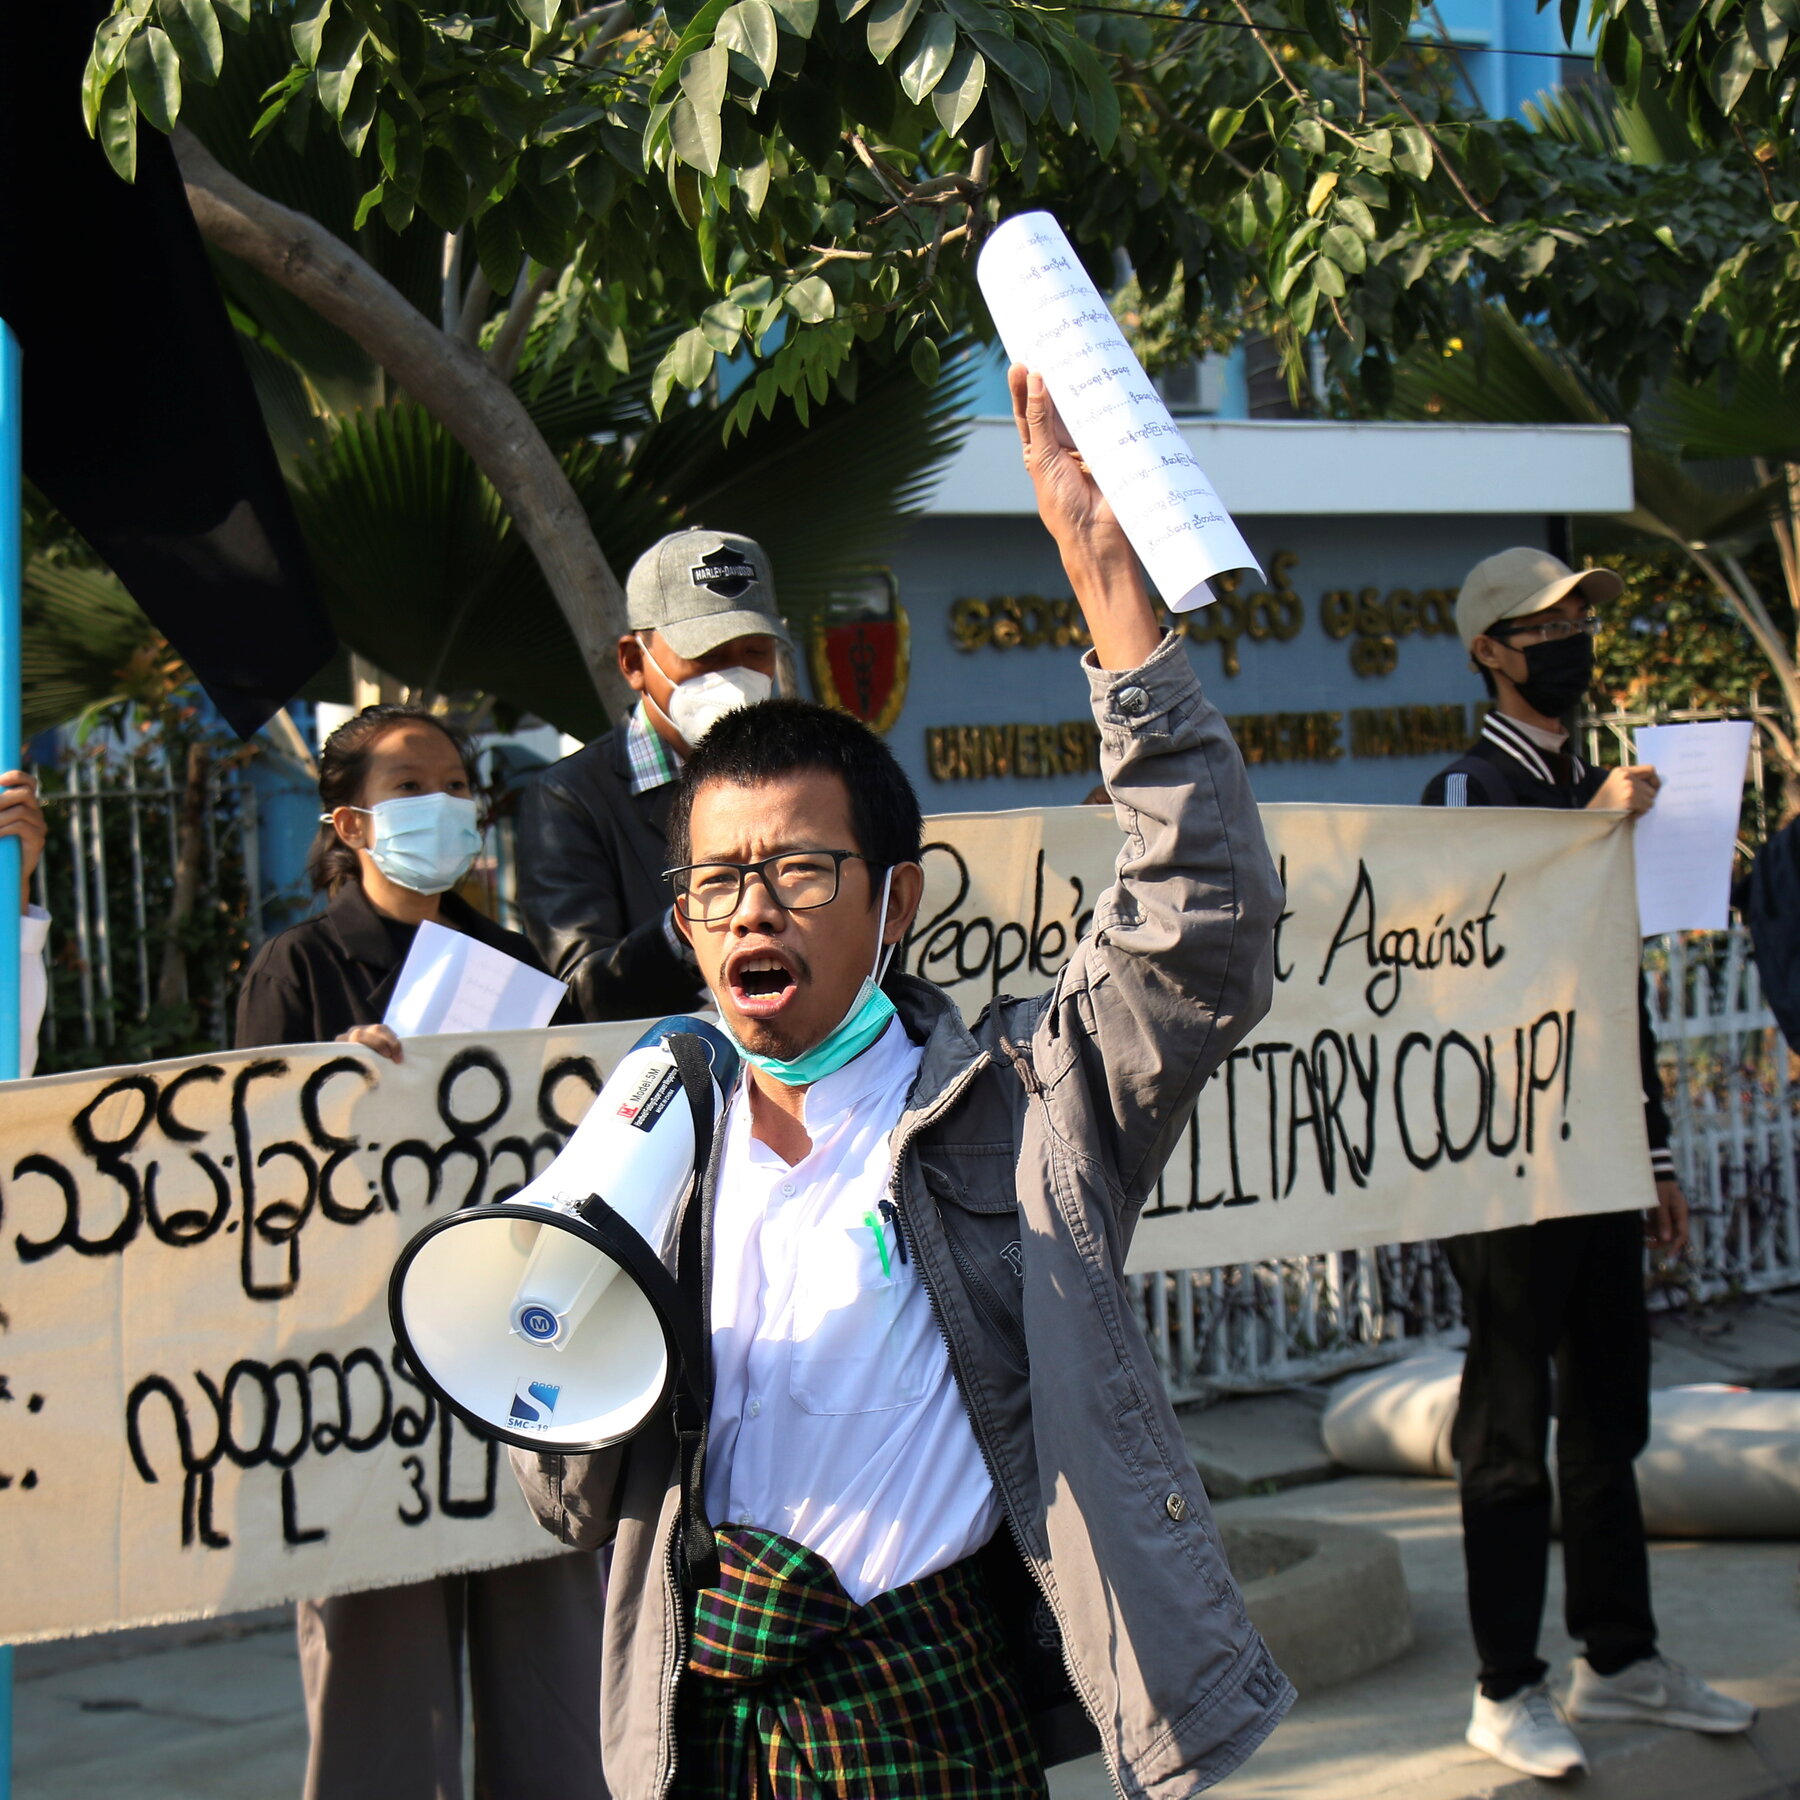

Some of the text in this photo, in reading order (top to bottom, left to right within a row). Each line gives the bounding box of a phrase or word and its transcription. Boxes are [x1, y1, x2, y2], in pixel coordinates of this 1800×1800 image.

[694, 565, 755, 581] HARLEY-DAVIDSON
[926, 722, 1102, 781] UNIVERSI
[1319, 858, 1506, 1017] Against
[1393, 1010, 1576, 1177] COUP!
